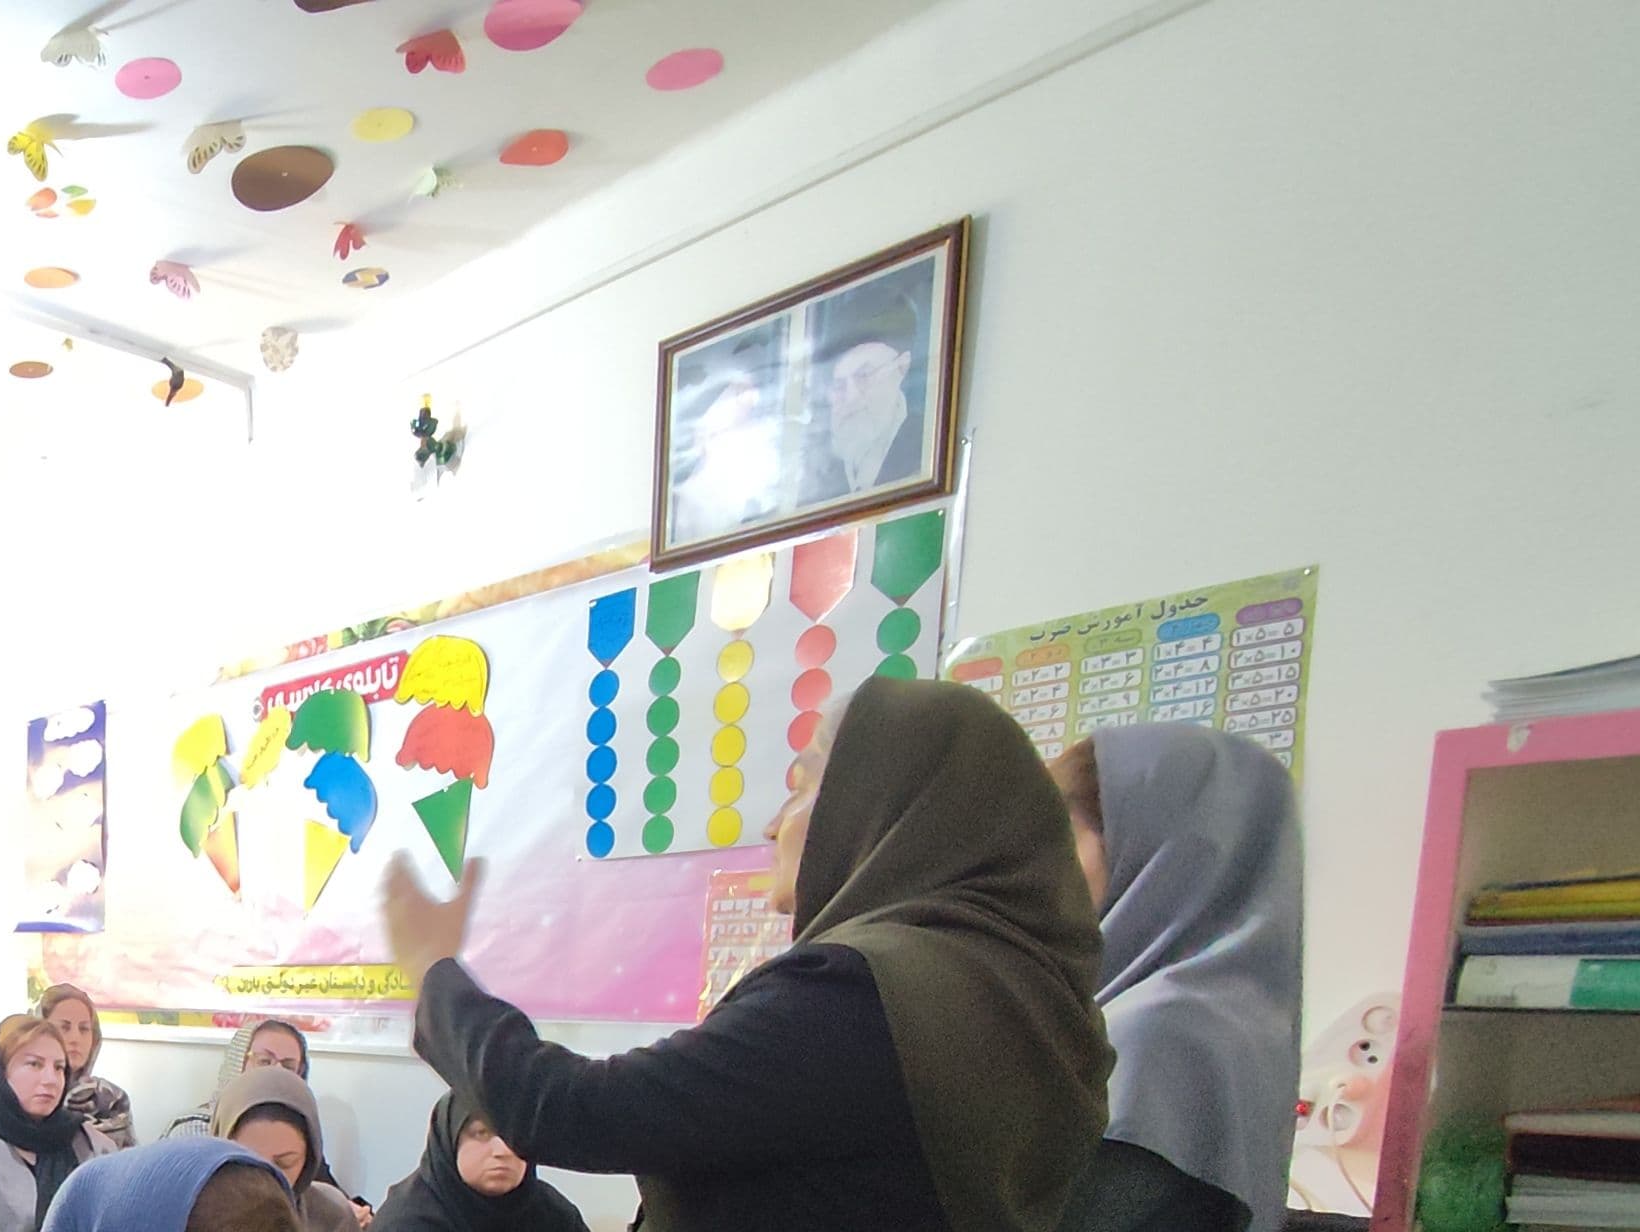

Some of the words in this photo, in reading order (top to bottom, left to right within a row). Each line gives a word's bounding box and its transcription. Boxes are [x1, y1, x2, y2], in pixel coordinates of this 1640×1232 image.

[1077, 602, 1145, 636] آموزش
[1150, 595, 1209, 621] جدول
[1029, 622, 1073, 643] ضرب
